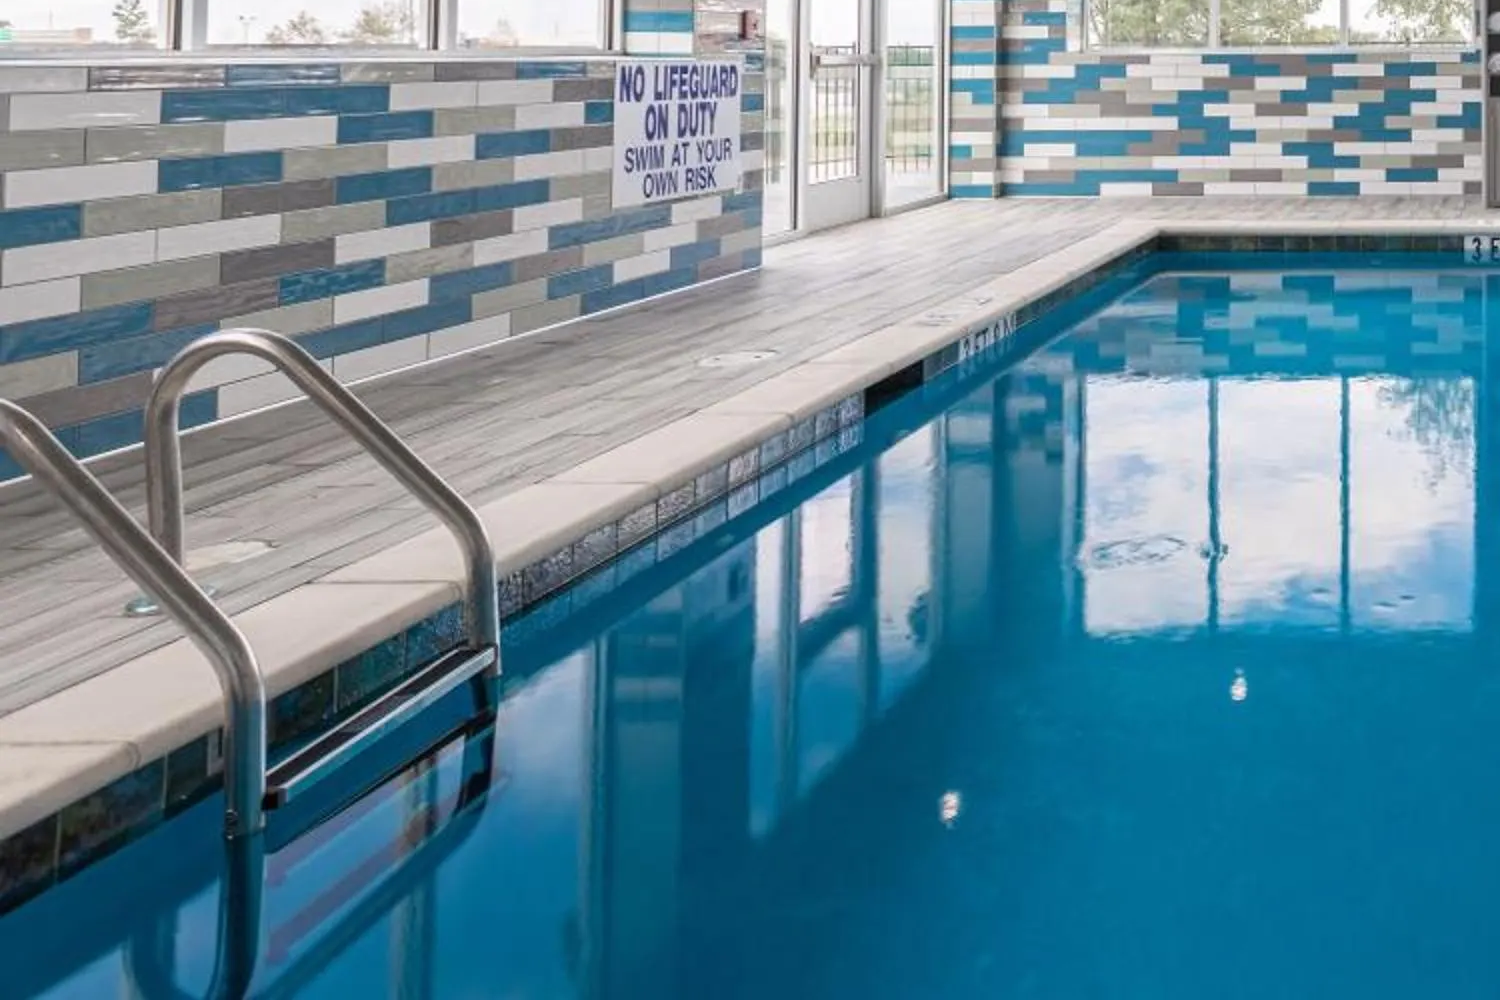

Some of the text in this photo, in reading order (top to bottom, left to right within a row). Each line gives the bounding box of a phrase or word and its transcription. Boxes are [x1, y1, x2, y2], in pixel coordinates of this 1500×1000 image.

[620, 64, 738, 102] NO LIFEGUARD
[645, 102, 718, 140] ON DUTY
[624, 138, 732, 173] SWIM AT YOUR
[643, 166, 716, 198] OWN RISK
